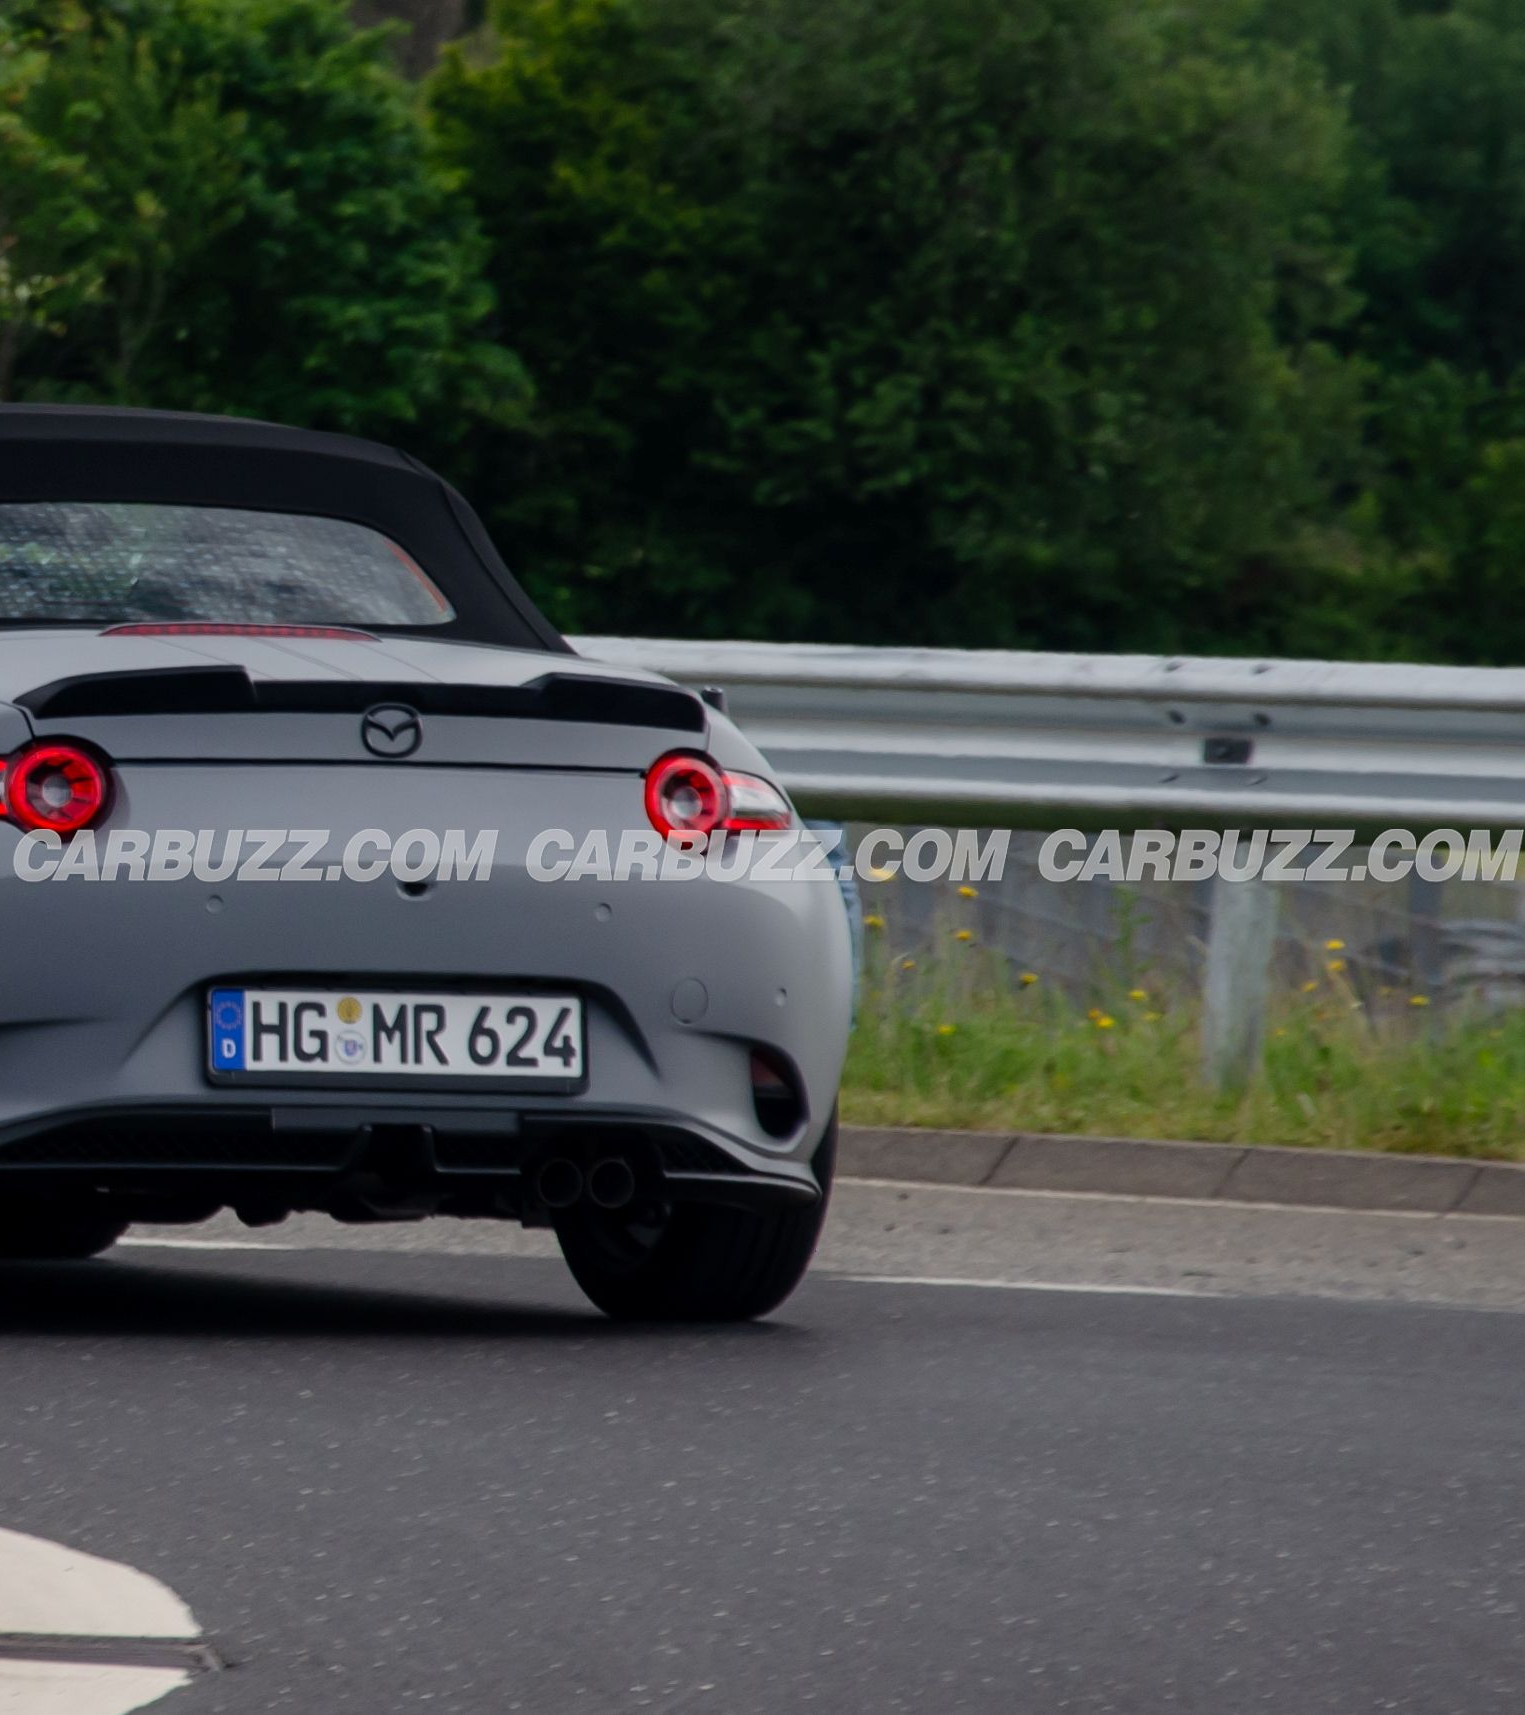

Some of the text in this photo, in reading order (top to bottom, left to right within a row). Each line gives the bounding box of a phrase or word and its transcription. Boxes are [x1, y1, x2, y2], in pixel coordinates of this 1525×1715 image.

[221, 1038, 237, 1059] D
[251, 1001, 577, 1068] HG MR 624
